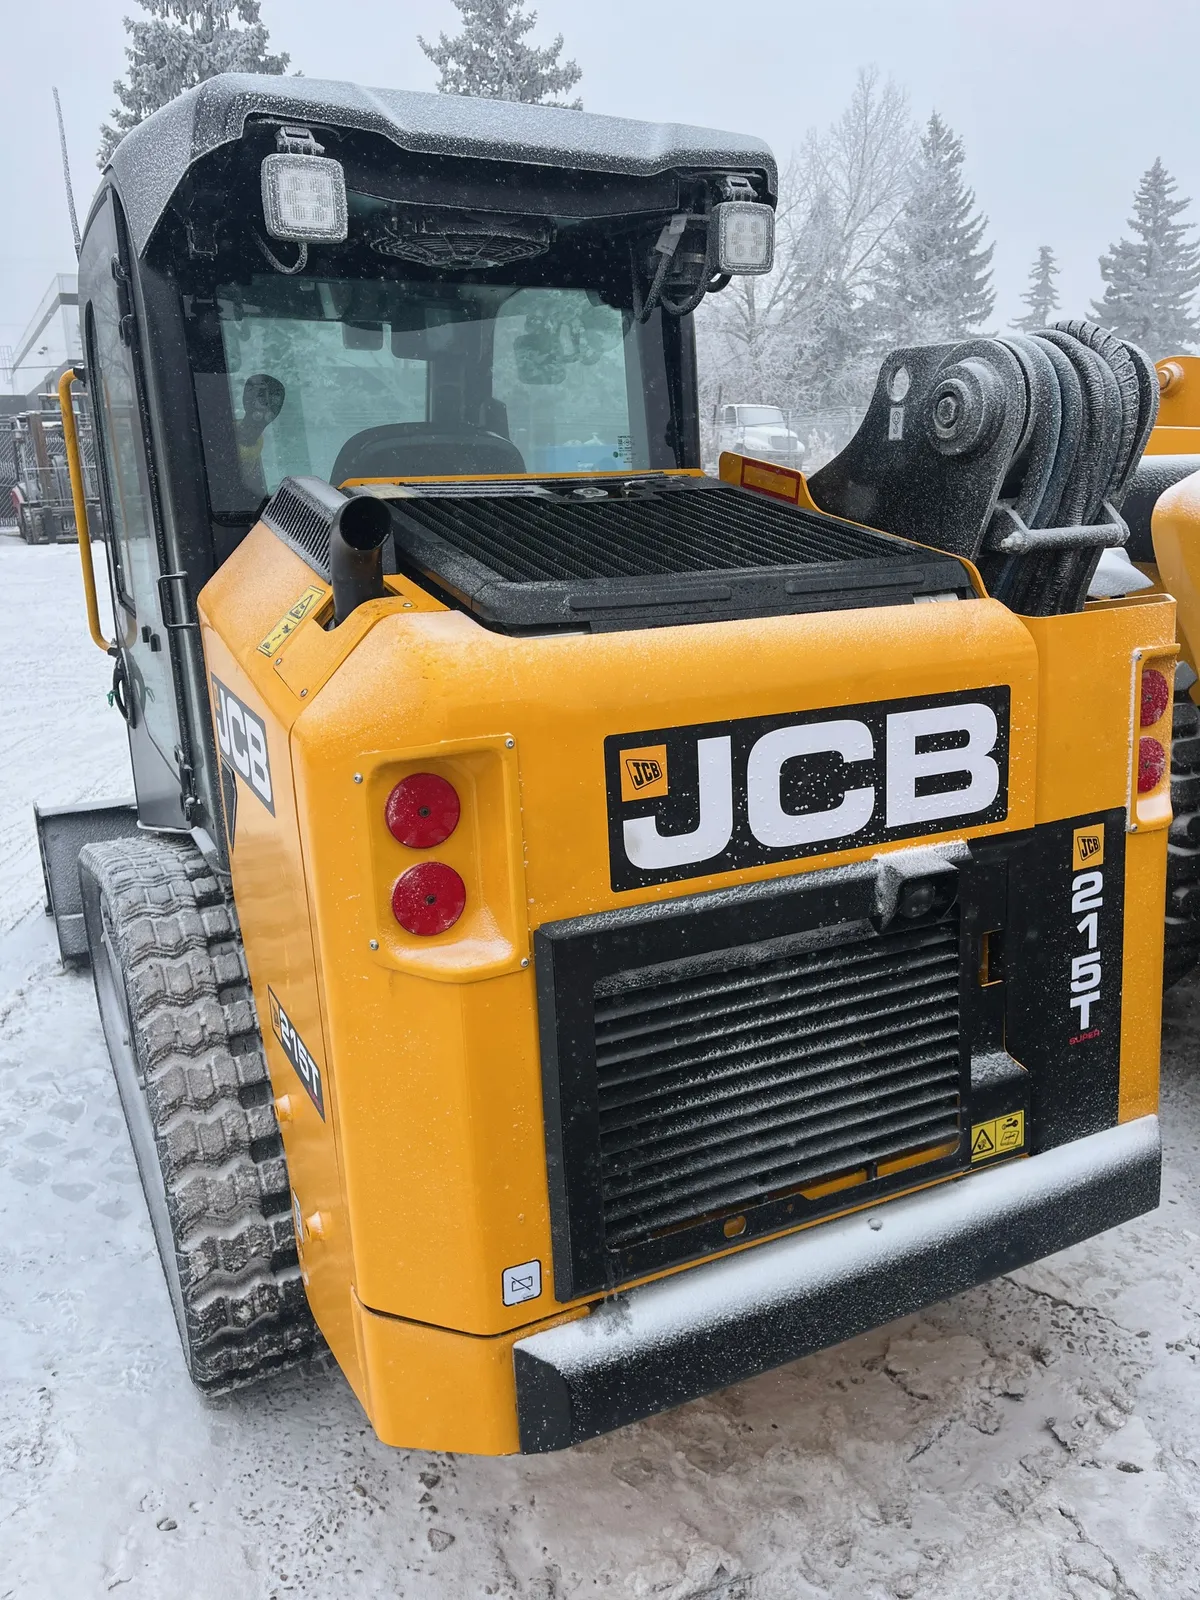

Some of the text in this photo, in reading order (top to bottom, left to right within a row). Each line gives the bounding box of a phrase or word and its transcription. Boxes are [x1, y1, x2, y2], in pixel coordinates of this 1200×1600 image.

[217, 688, 271, 803] JCB
[623, 703, 999, 870] JCB
[632, 762, 660, 786] JCB
[1081, 838, 1100, 858] JCB
[1070, 871, 1103, 1030] 215T
[280, 1008, 319, 1097] 215T
[1069, 1029, 1100, 1045] SUPER
